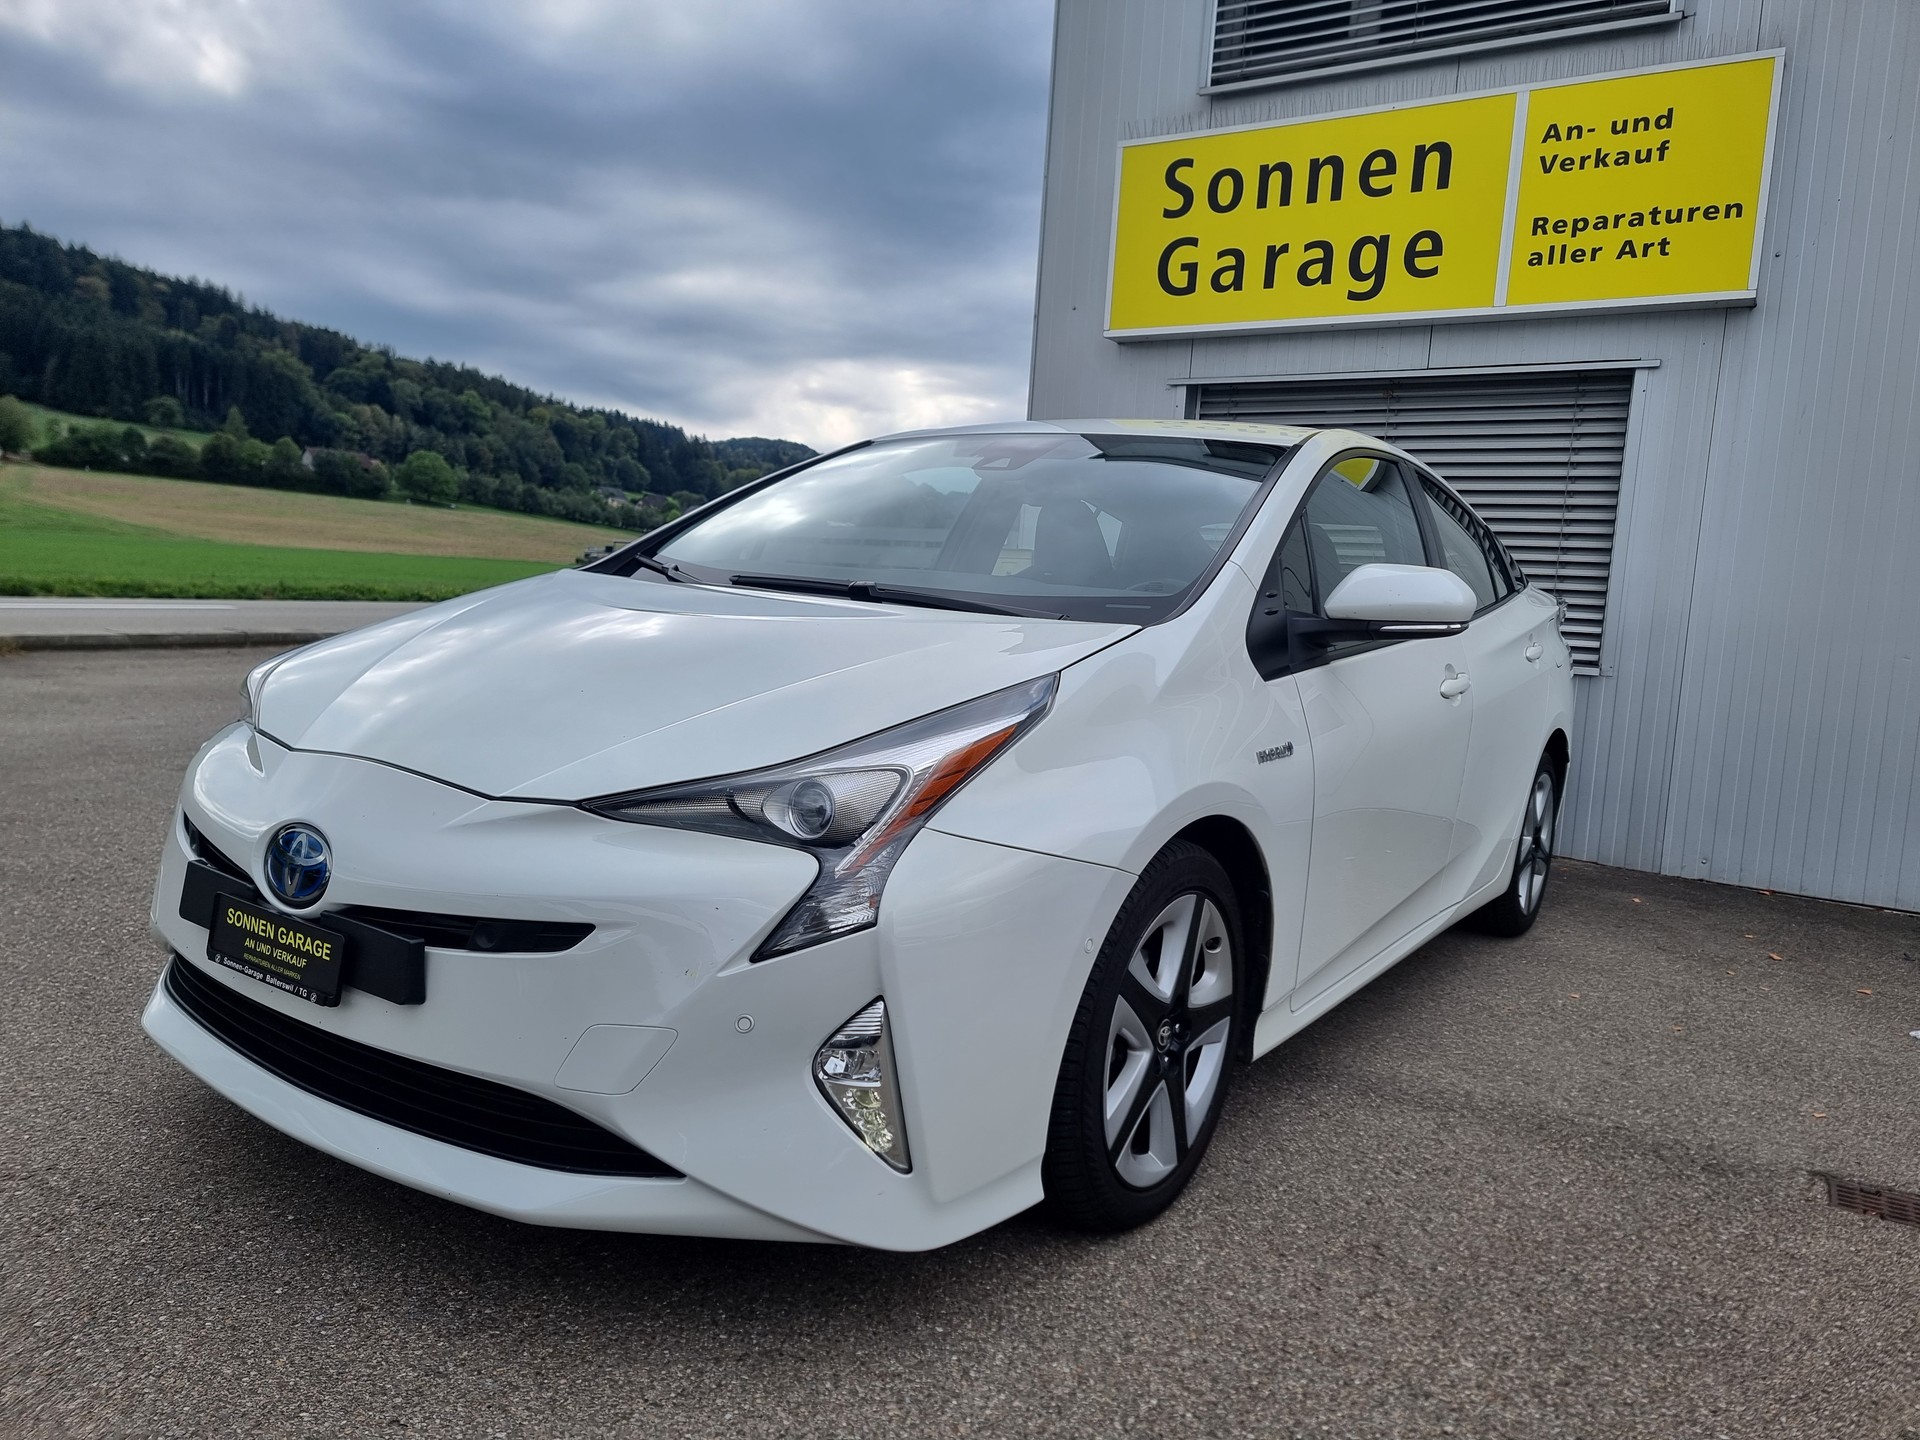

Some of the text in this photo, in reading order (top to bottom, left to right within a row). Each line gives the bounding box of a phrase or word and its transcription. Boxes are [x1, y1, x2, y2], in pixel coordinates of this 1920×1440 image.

[1541, 107, 1674, 144] An- und
[1539, 140, 1671, 175] Verkauf
[1163, 141, 1453, 219] Sonnen
[1531, 202, 1744, 238] Reparaturen
[1157, 229, 1444, 302] Garage
[1527, 236, 1671, 267] aller Art
[226, 908, 332, 961] SONNEN GARAGE
[244, 937, 308, 969] AN UND VERKAUF
[223, 957, 264, 980] Sonnen-Garage
[265, 974, 294, 992] Balterswil
[299, 987, 308, 997] TG
